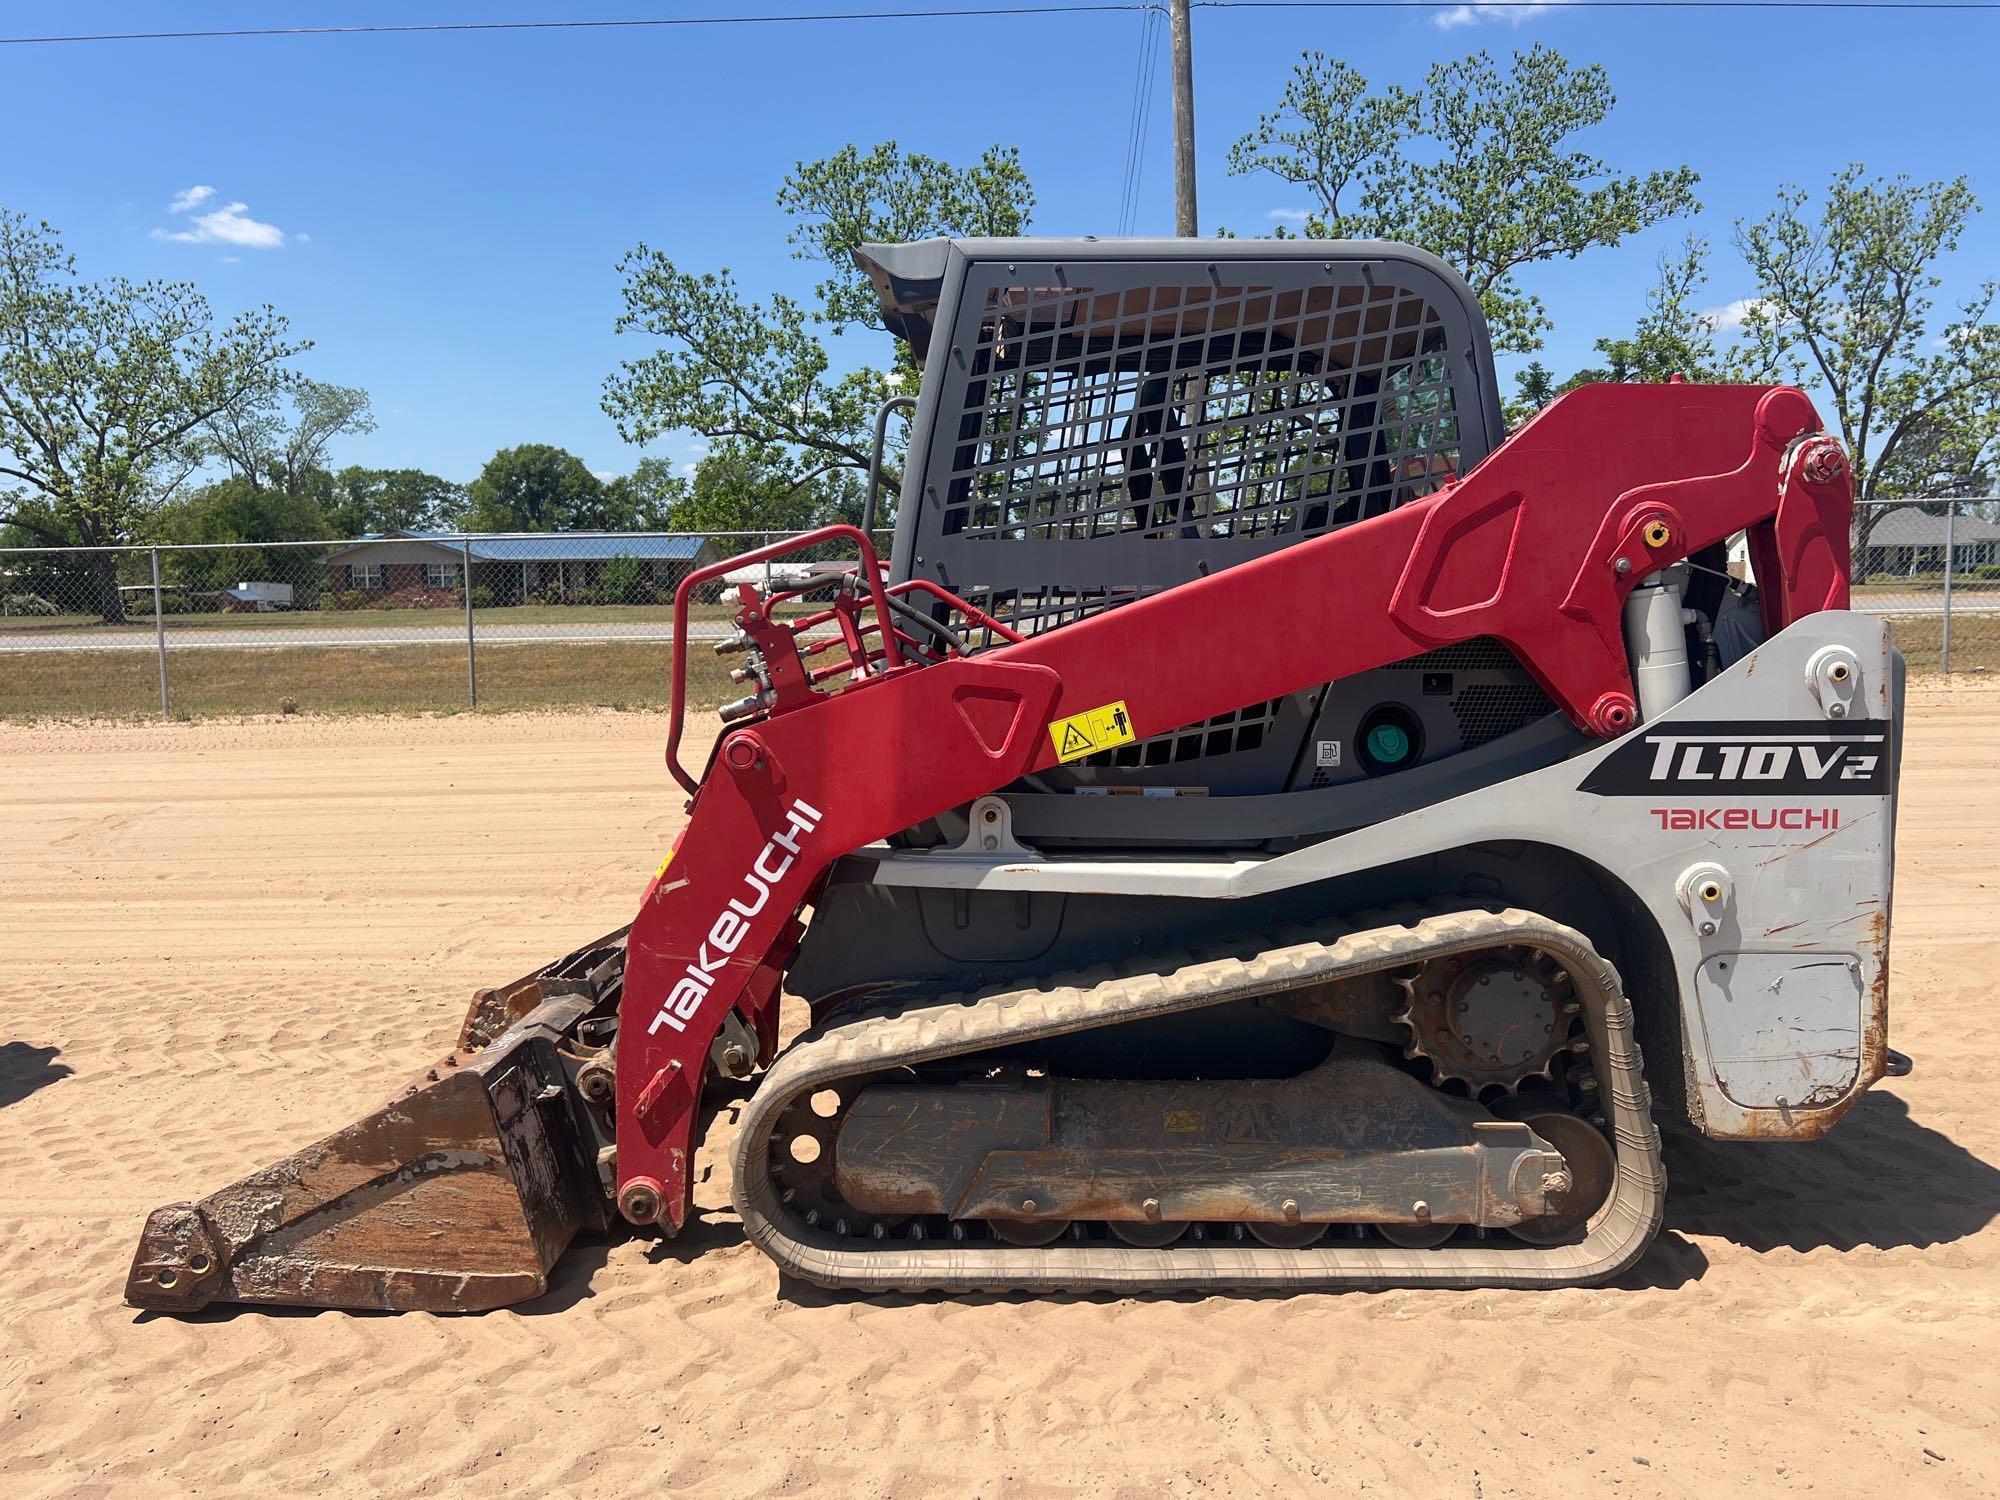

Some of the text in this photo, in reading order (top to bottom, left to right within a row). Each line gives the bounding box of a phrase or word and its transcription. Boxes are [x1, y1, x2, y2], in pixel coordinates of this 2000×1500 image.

[1646, 735, 1885, 780] TL10V2
[1651, 808, 1840, 830] TAKEUCHI
[648, 799, 823, 1035] TAKEUCHI
